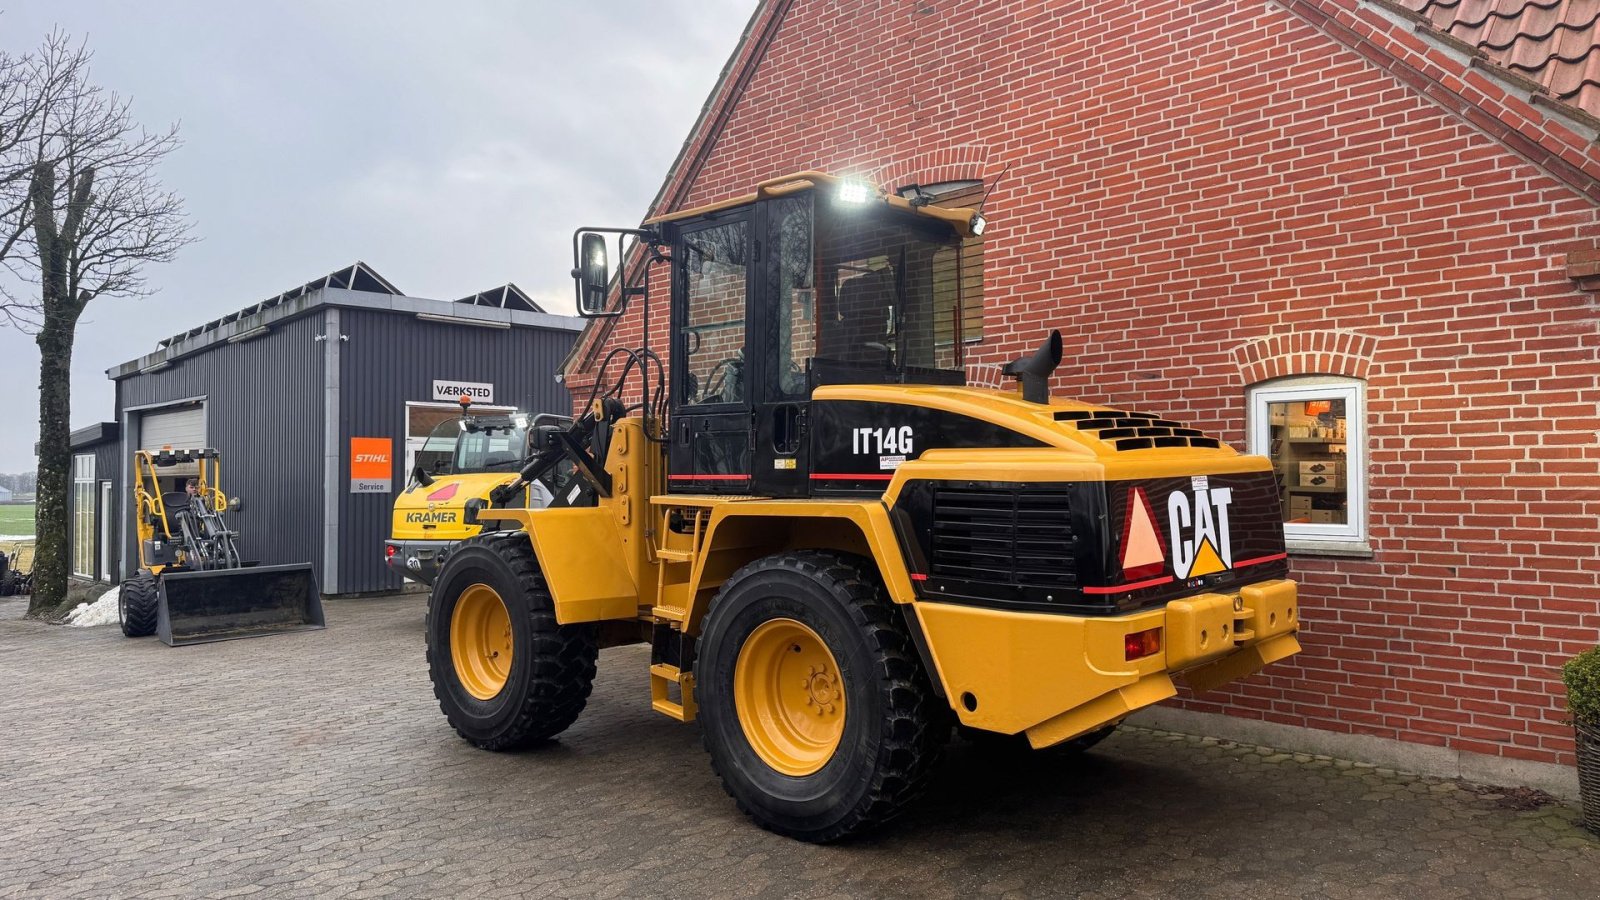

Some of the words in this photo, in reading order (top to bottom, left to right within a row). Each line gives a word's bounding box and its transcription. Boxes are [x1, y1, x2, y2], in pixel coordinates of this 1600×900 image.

[436, 385, 491, 398] VÆRKSTED
[853, 425, 913, 454] IT14G
[355, 454, 388, 463] STIHL
[358, 482, 384, 490] Service
[406, 512, 457, 523] KRAMER
[1167, 487, 1233, 580] CAT
